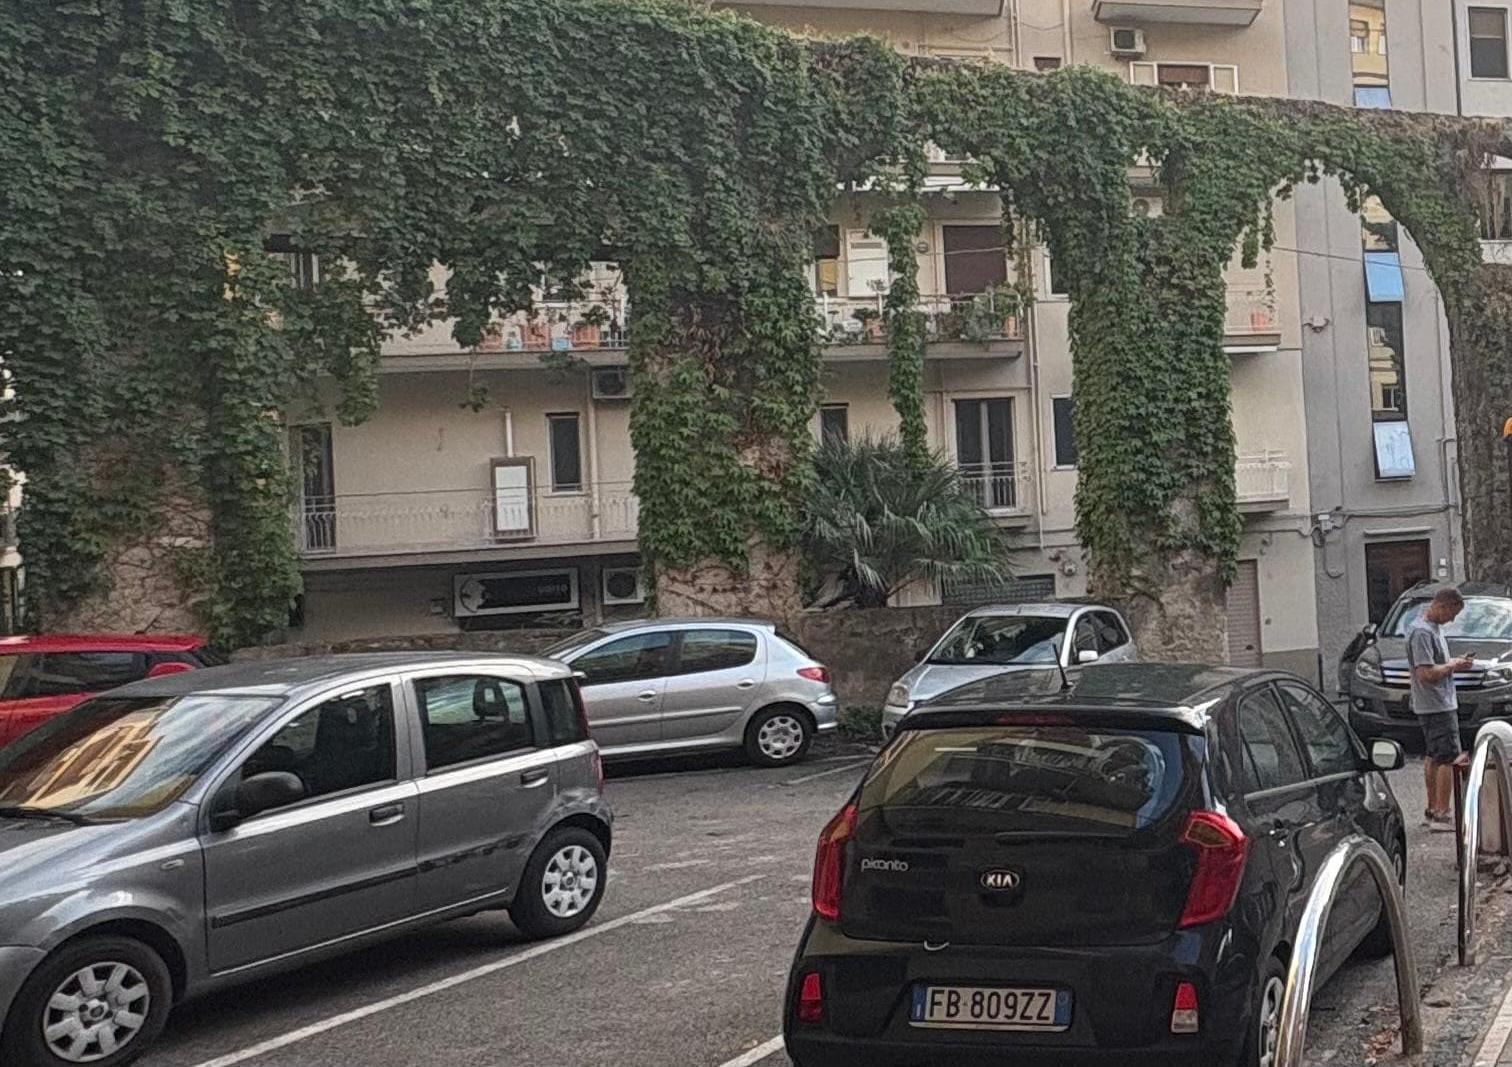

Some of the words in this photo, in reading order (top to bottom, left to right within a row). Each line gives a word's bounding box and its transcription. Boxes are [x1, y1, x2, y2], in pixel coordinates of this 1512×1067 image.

[861, 857, 908, 872] picanto
[986, 873, 1013, 887] KIA
[929, 989, 961, 1018] FB
[970, 990, 1052, 1021] 809ZZ
